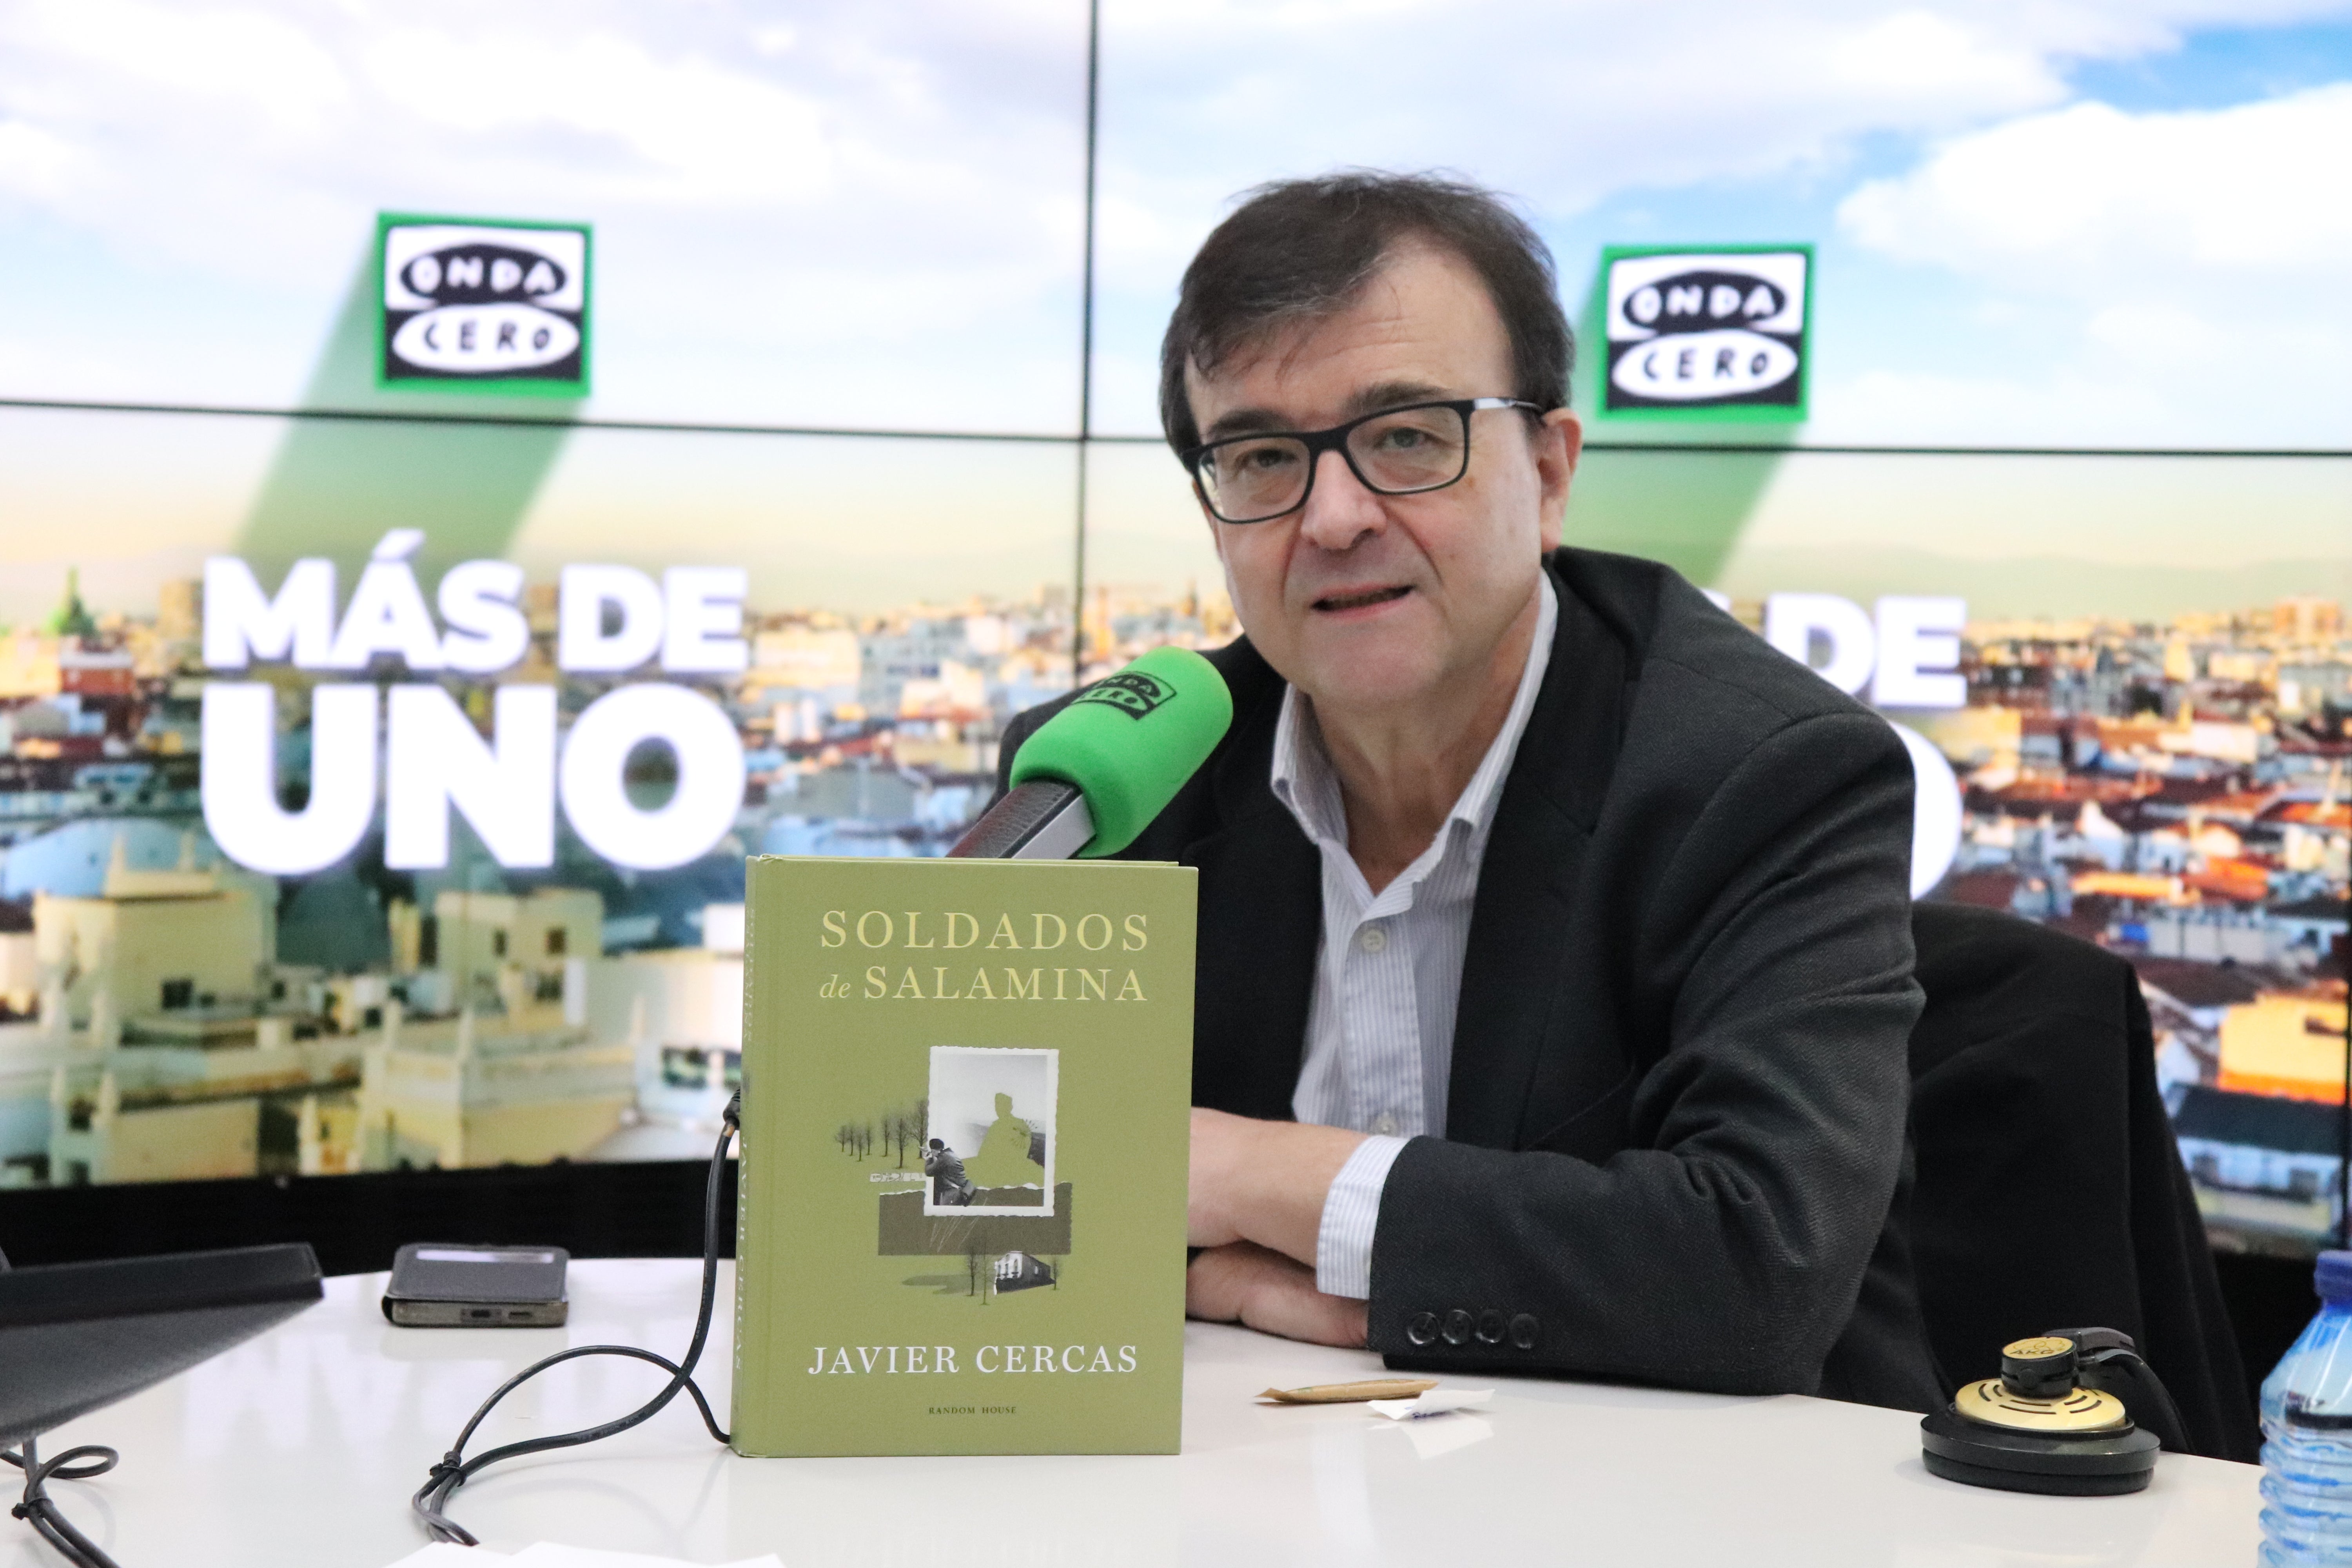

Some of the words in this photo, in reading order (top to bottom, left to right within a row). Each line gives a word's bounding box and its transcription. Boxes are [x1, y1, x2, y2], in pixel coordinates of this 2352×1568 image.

[409, 256, 556, 293] ONDA
[1631, 285, 1776, 323] ONDA
[423, 320, 550, 351] CERO
[1643, 347, 1768, 380] CERO
[201, 528, 532, 673] MÁS
[558, 563, 749, 673] DE
[200, 682, 747, 875] UNO
[821, 910, 1148, 951] SOLDADOS
[820, 974, 851, 999] de
[864, 966, 1148, 1001] SALAMINA
[808, 1346, 960, 1374] JAVIER
[976, 1345, 1137, 1373] CERCAS
